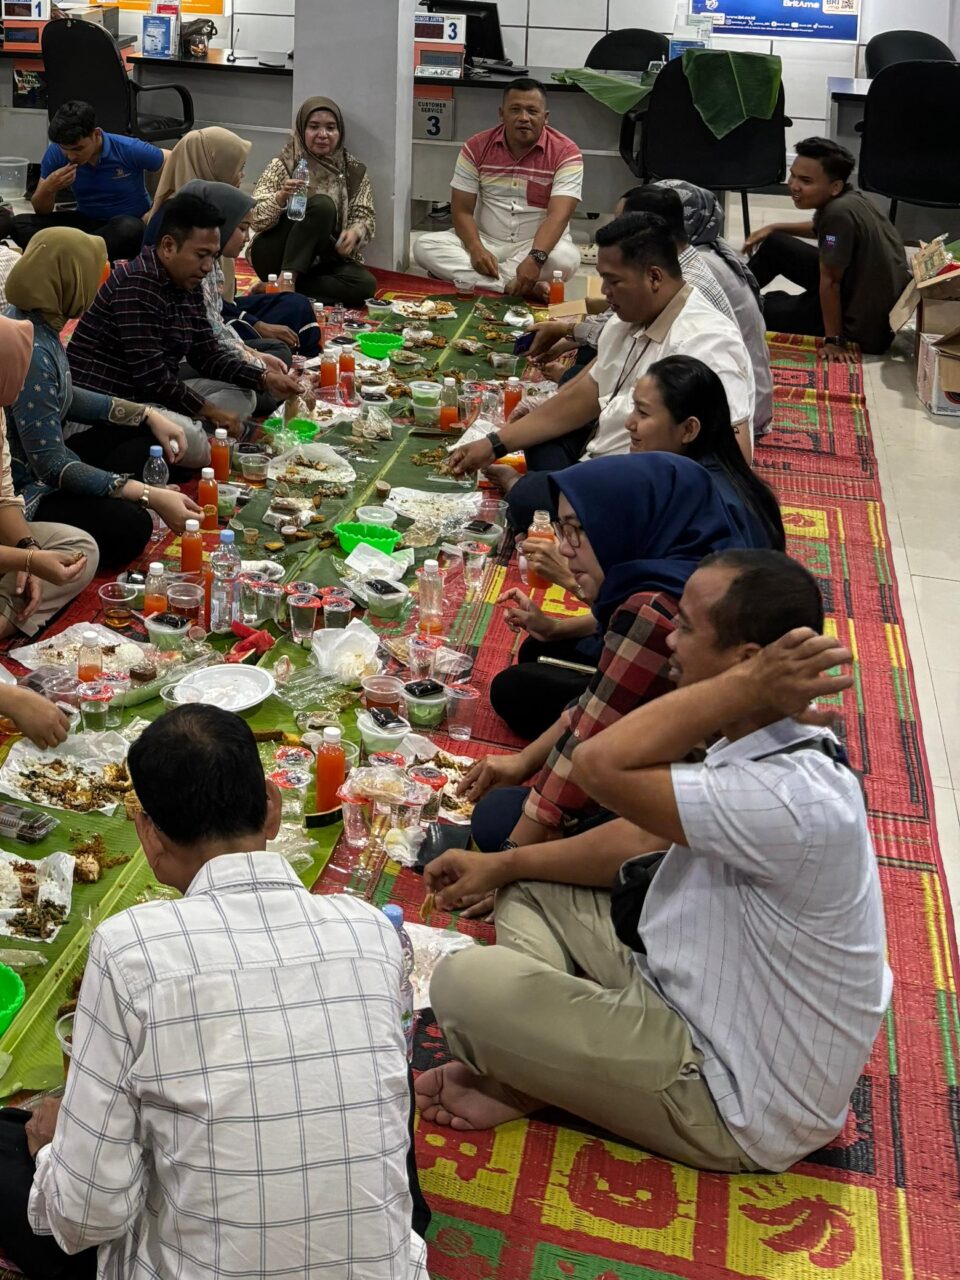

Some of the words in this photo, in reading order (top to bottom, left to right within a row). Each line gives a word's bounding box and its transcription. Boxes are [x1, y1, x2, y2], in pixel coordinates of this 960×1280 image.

[35, 1, 41, 17] 1
[448, 22, 457, 40] 3
[427, 116, 440, 136] 3
